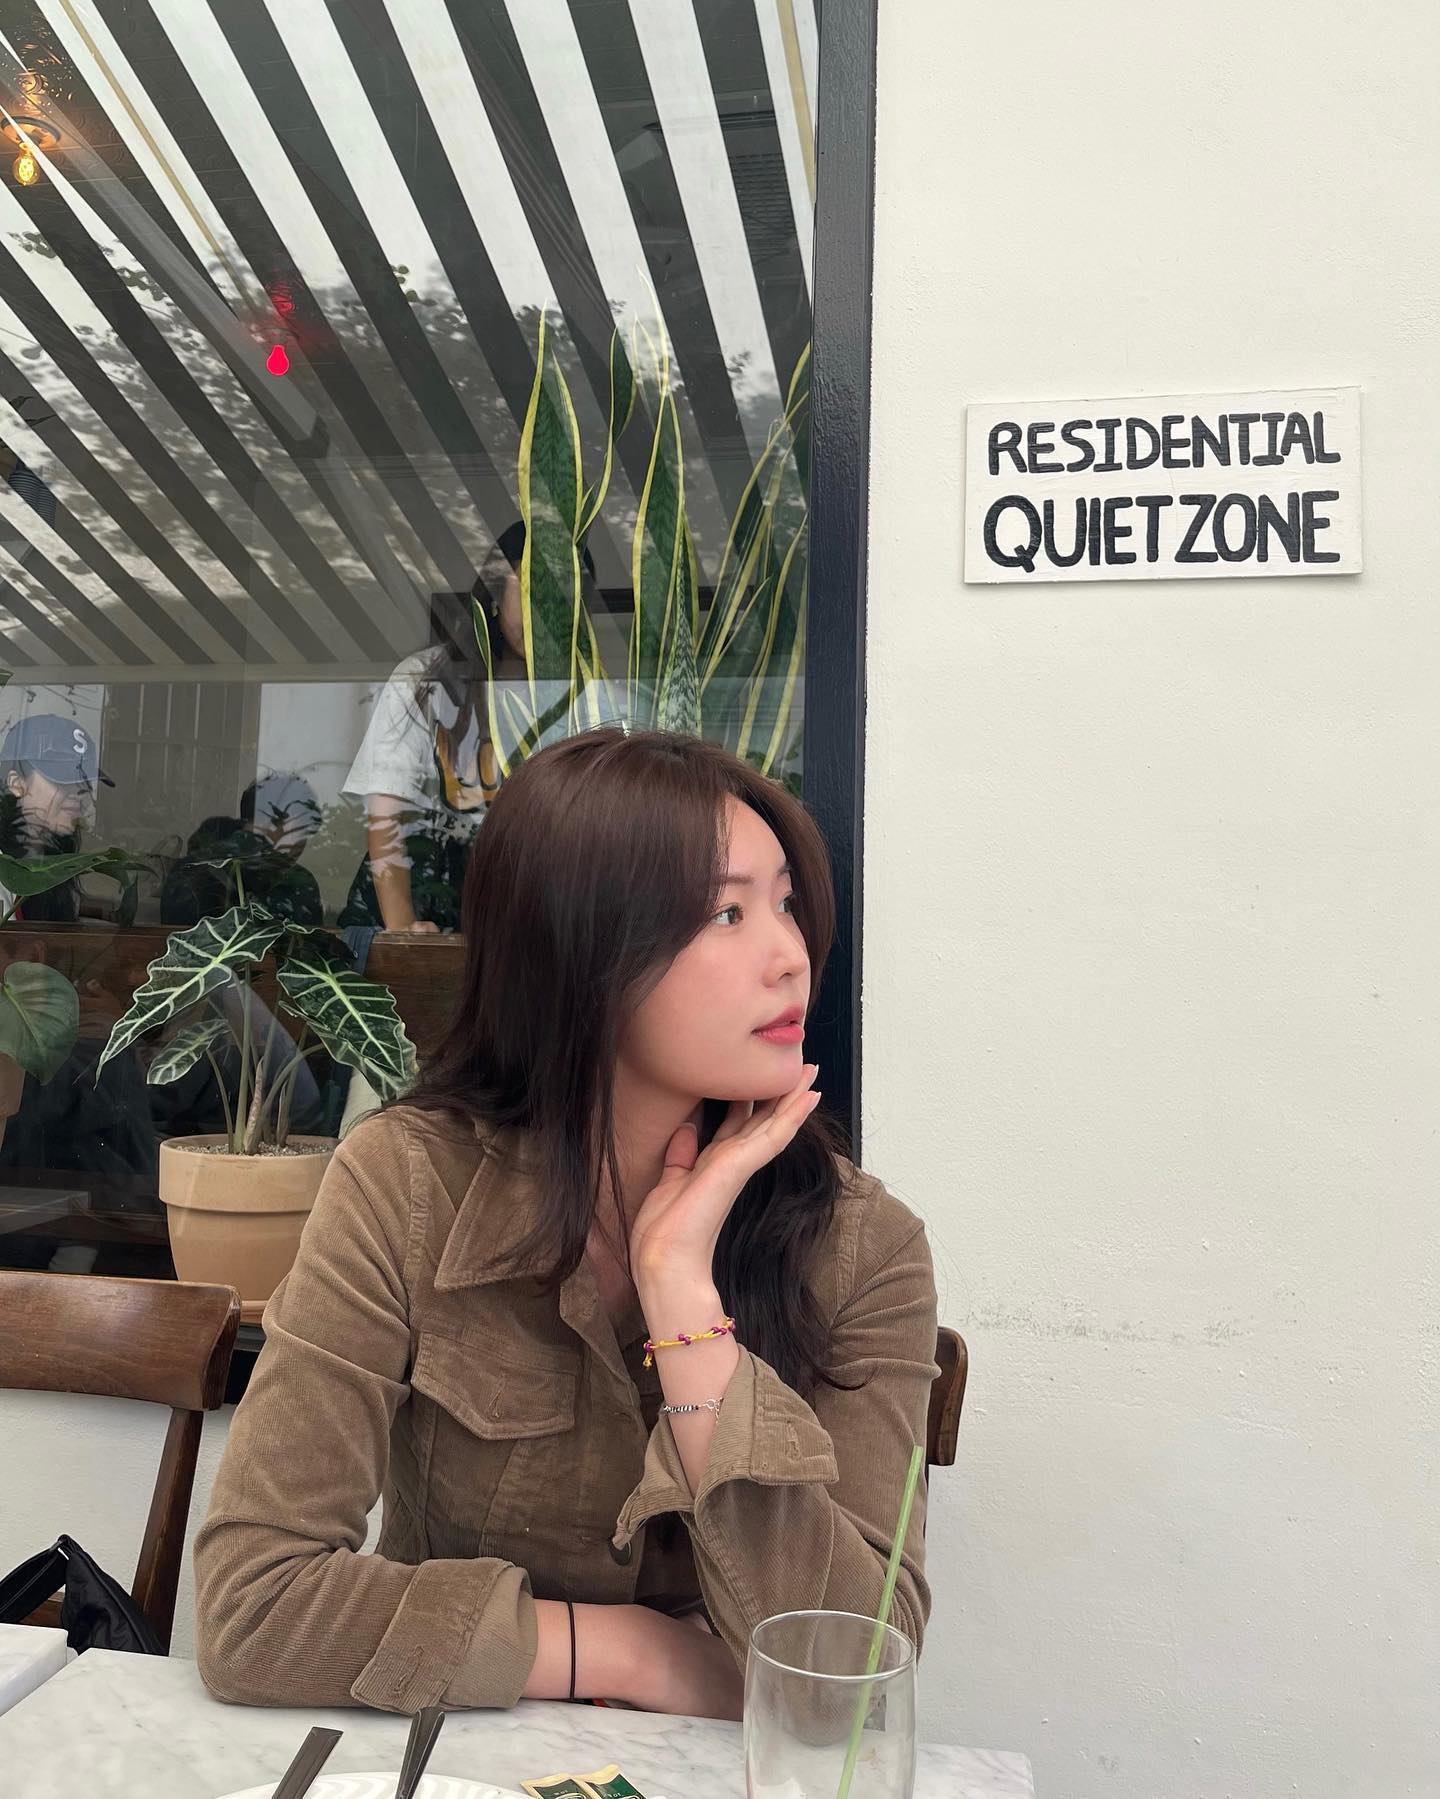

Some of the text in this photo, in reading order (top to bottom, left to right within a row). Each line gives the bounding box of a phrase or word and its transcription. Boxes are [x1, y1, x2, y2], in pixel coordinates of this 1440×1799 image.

[988, 411, 1341, 475] RESIDENTIAL
[983, 490, 1340, 572] QUIET ZONE
[73, 728, 87, 753] S
